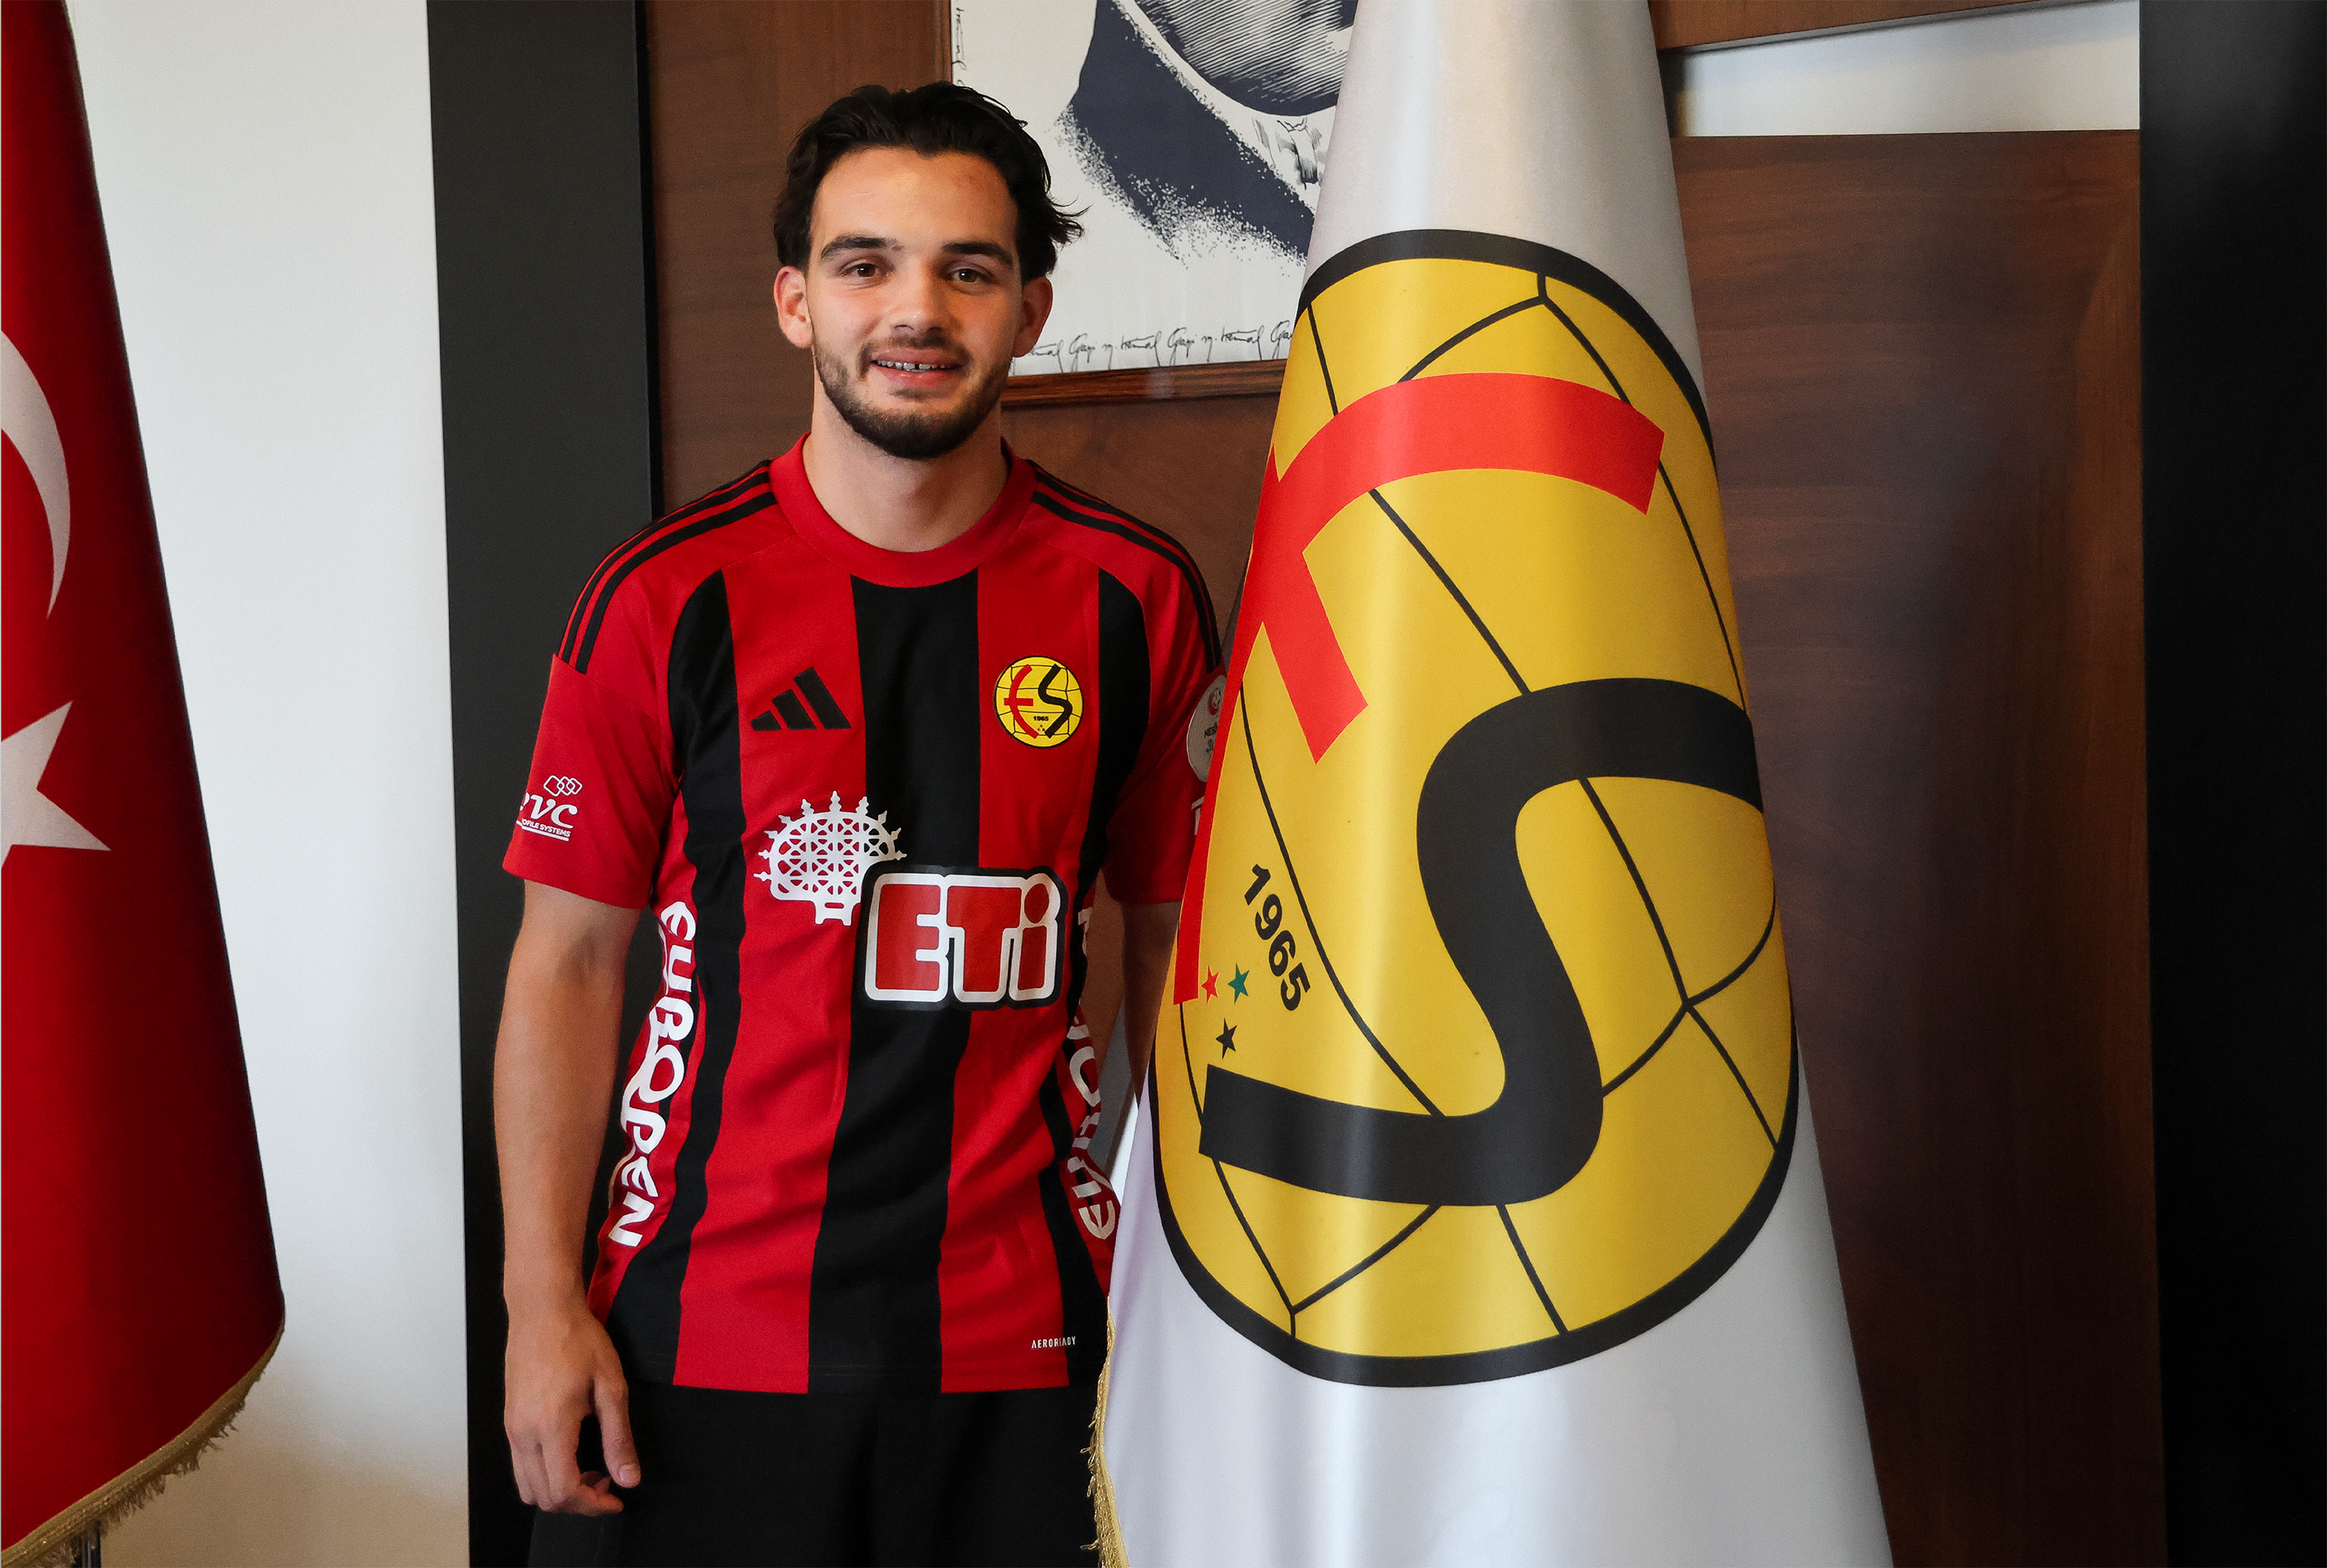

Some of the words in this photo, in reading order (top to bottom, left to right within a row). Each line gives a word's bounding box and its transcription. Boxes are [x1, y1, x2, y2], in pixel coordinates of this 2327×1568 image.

[539, 823, 572, 838] SYSTEMS
[1245, 864, 1311, 1011] 1965
[1031, 1335, 1076, 1349] AEROREADY
